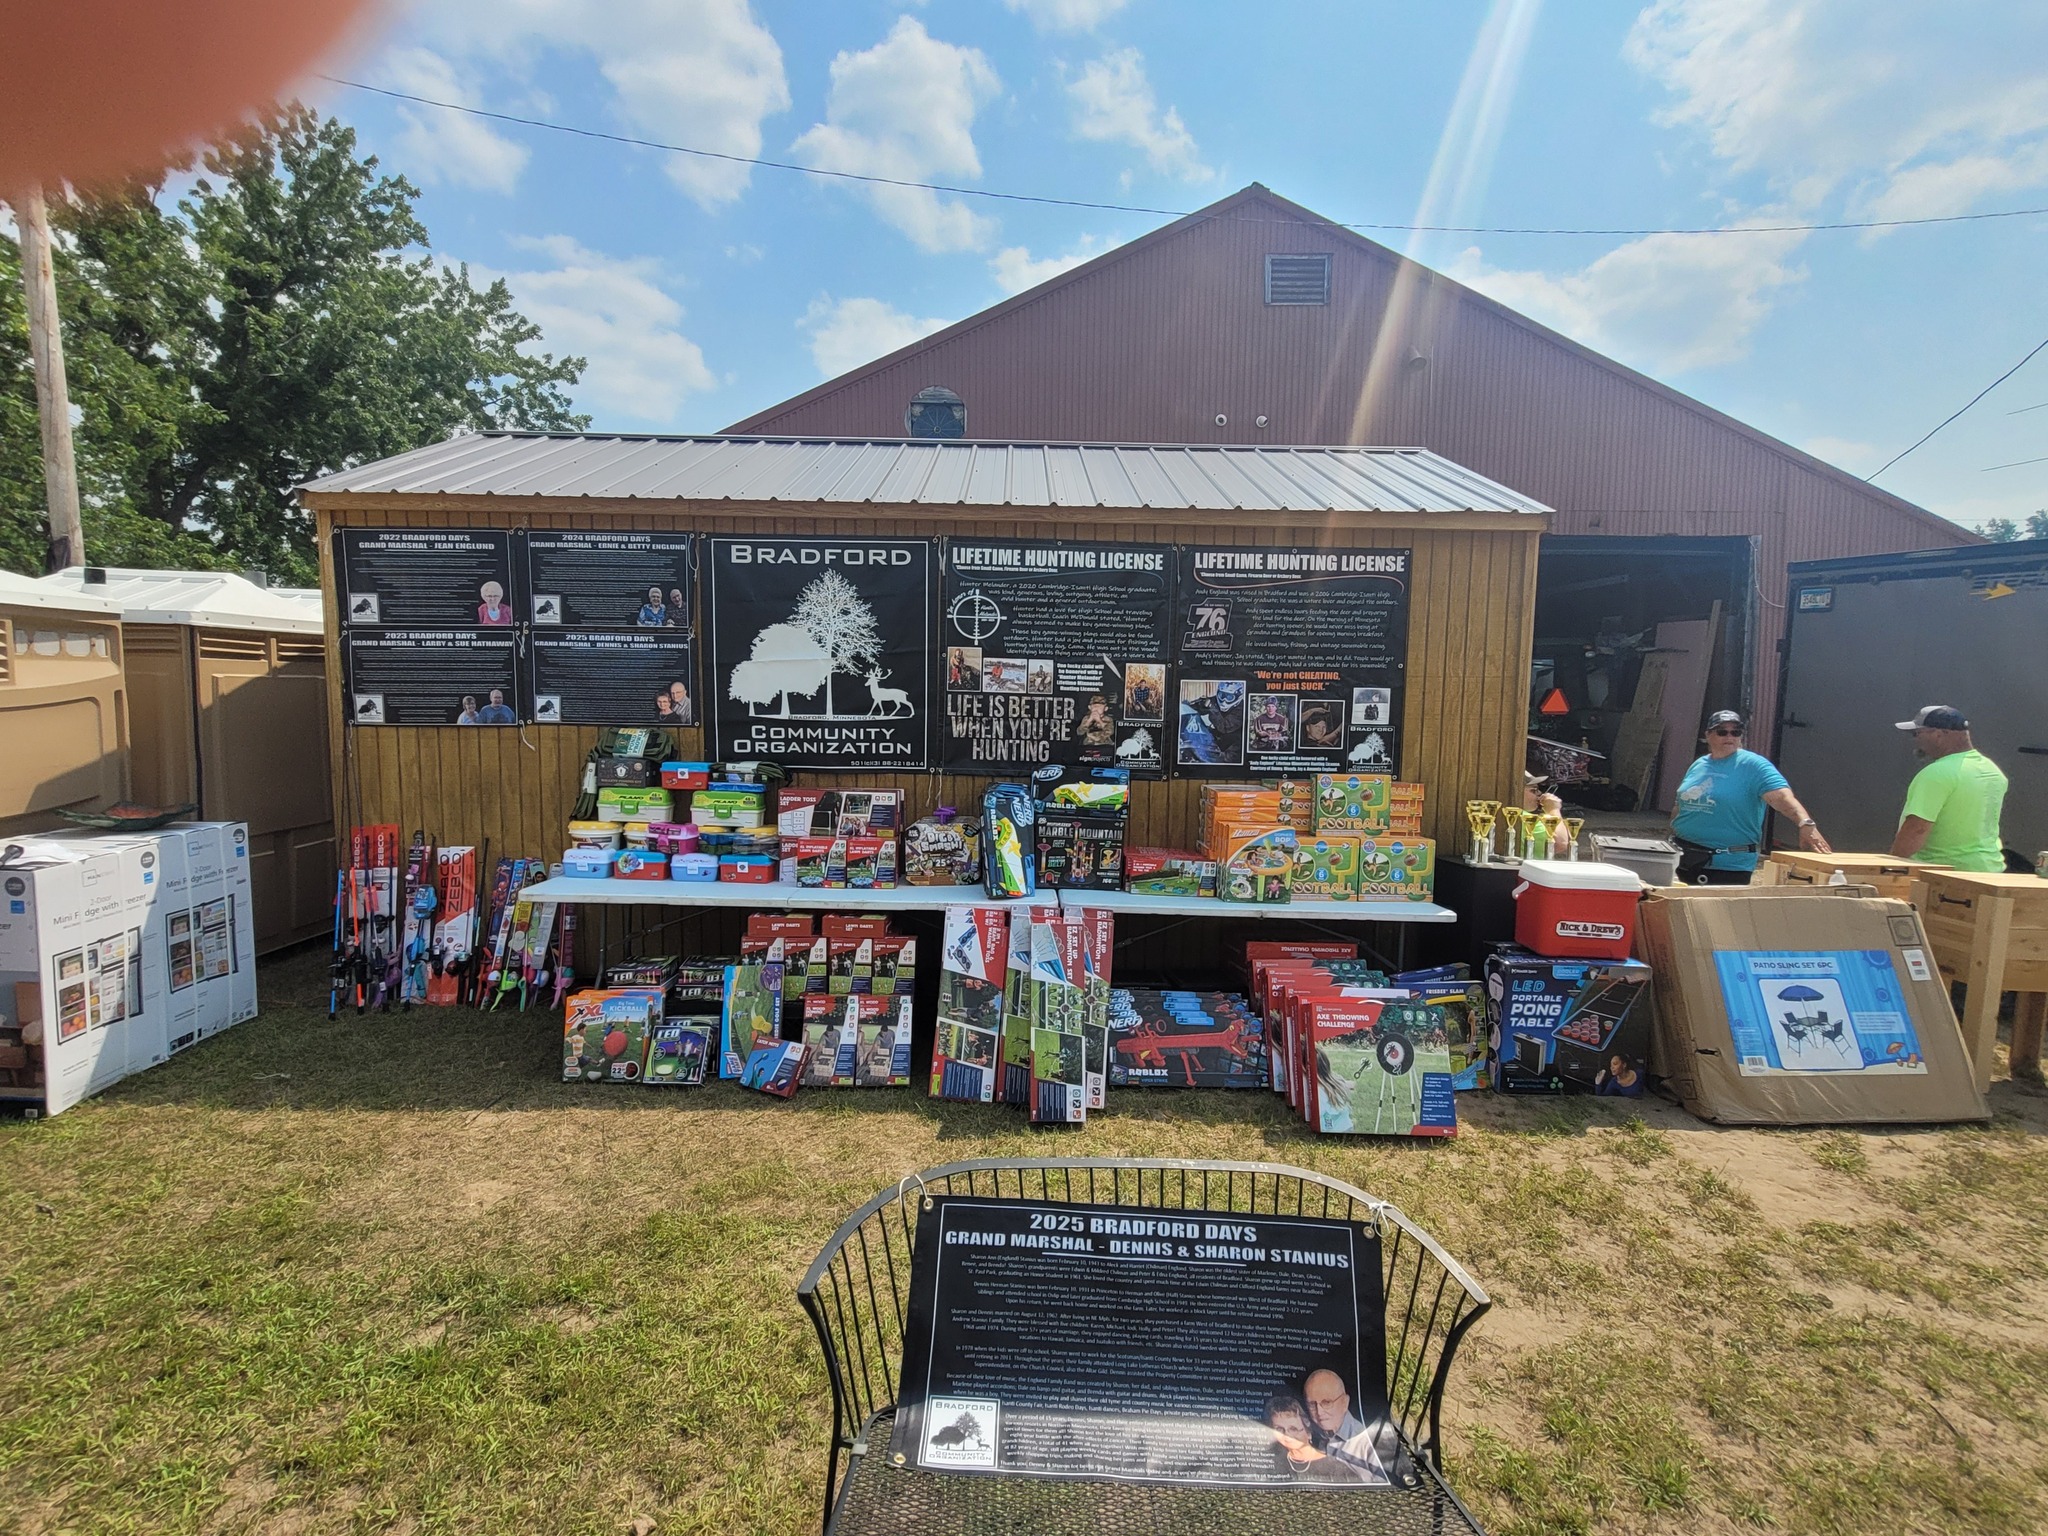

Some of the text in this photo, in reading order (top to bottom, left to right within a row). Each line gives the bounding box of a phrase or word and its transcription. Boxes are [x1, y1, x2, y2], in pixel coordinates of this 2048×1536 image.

[448, 534, 470, 542] DAYS
[731, 544, 911, 566] BRADFORD
[952, 547, 1163, 571] LIFETIME HUNTING LICENSE
[1195, 552, 1405, 572] LIFETIME HUNTING LICENSE
[1195, 608, 1227, 630] 76
[409, 632, 454, 640] BRADFORD
[1283, 671, 1297, 680] not
[1298, 671, 1340, 680] CHEATING,
[1266, 682, 1280, 690] you
[1282, 682, 1300, 690] just
[947, 694, 1075, 719] LIFE IS BETTER
[751, 725, 896, 740] COMMUNITY
[951, 716, 1072, 741] WHEN YOU'RE
[733, 739, 911, 755] ORGANIZATION
[972, 738, 1050, 763] HUNTING
[1032, 769, 1063, 779] NERF
[1012, 797, 1026, 827] NERF
[990, 808, 999, 841] ROBLOX
[1318, 817, 1388, 830] FOOTBALL
[927, 832, 947, 843] DIG
[1038, 826, 1123, 840] MARBLE MOUNTAIN
[377, 834, 385, 866] ZEBCO
[920, 841, 964, 852] SMASH!
[166, 870, 218, 889] Mini with
[448, 852, 461, 912] ZEBCO
[1361, 882, 1431, 895] FOOTBALL
[52, 901, 119, 926] Mini with
[1560, 922, 1580, 931] NICK
[1582, 924, 1589, 932] &
[1590, 924, 1622, 936] DREW'S
[1072, 949, 1078, 959] UP
[1101, 944, 1107, 953] UP
[613, 972, 633, 982] LED
[1511, 979, 1546, 992] LED
[682, 988, 702, 997] LED
[1511, 994, 1563, 1002] PORTABLE
[1510, 1003, 1562, 1016] PONG
[1108, 1015, 1143, 1029] NERF
[1509, 1017, 1555, 1027] TABLE
[657, 1028, 680, 1039] LED
[1128, 1068, 1169, 1076] ROBLOX
[1030, 1214, 1257, 1242] 2025 BRADFORD DAYS
[945, 1230, 1006, 1247] GRAND
[1010, 1233, 1094, 1252] MARSHAL
[1110, 1240, 1173, 1256] DENNIS
[1177, 1245, 1190, 1257] &
[1194, 1244, 1266, 1262] SHARON
[1270, 1248, 1349, 1268] STANIUS
[935, 1401, 994, 1412] BRADFORD
